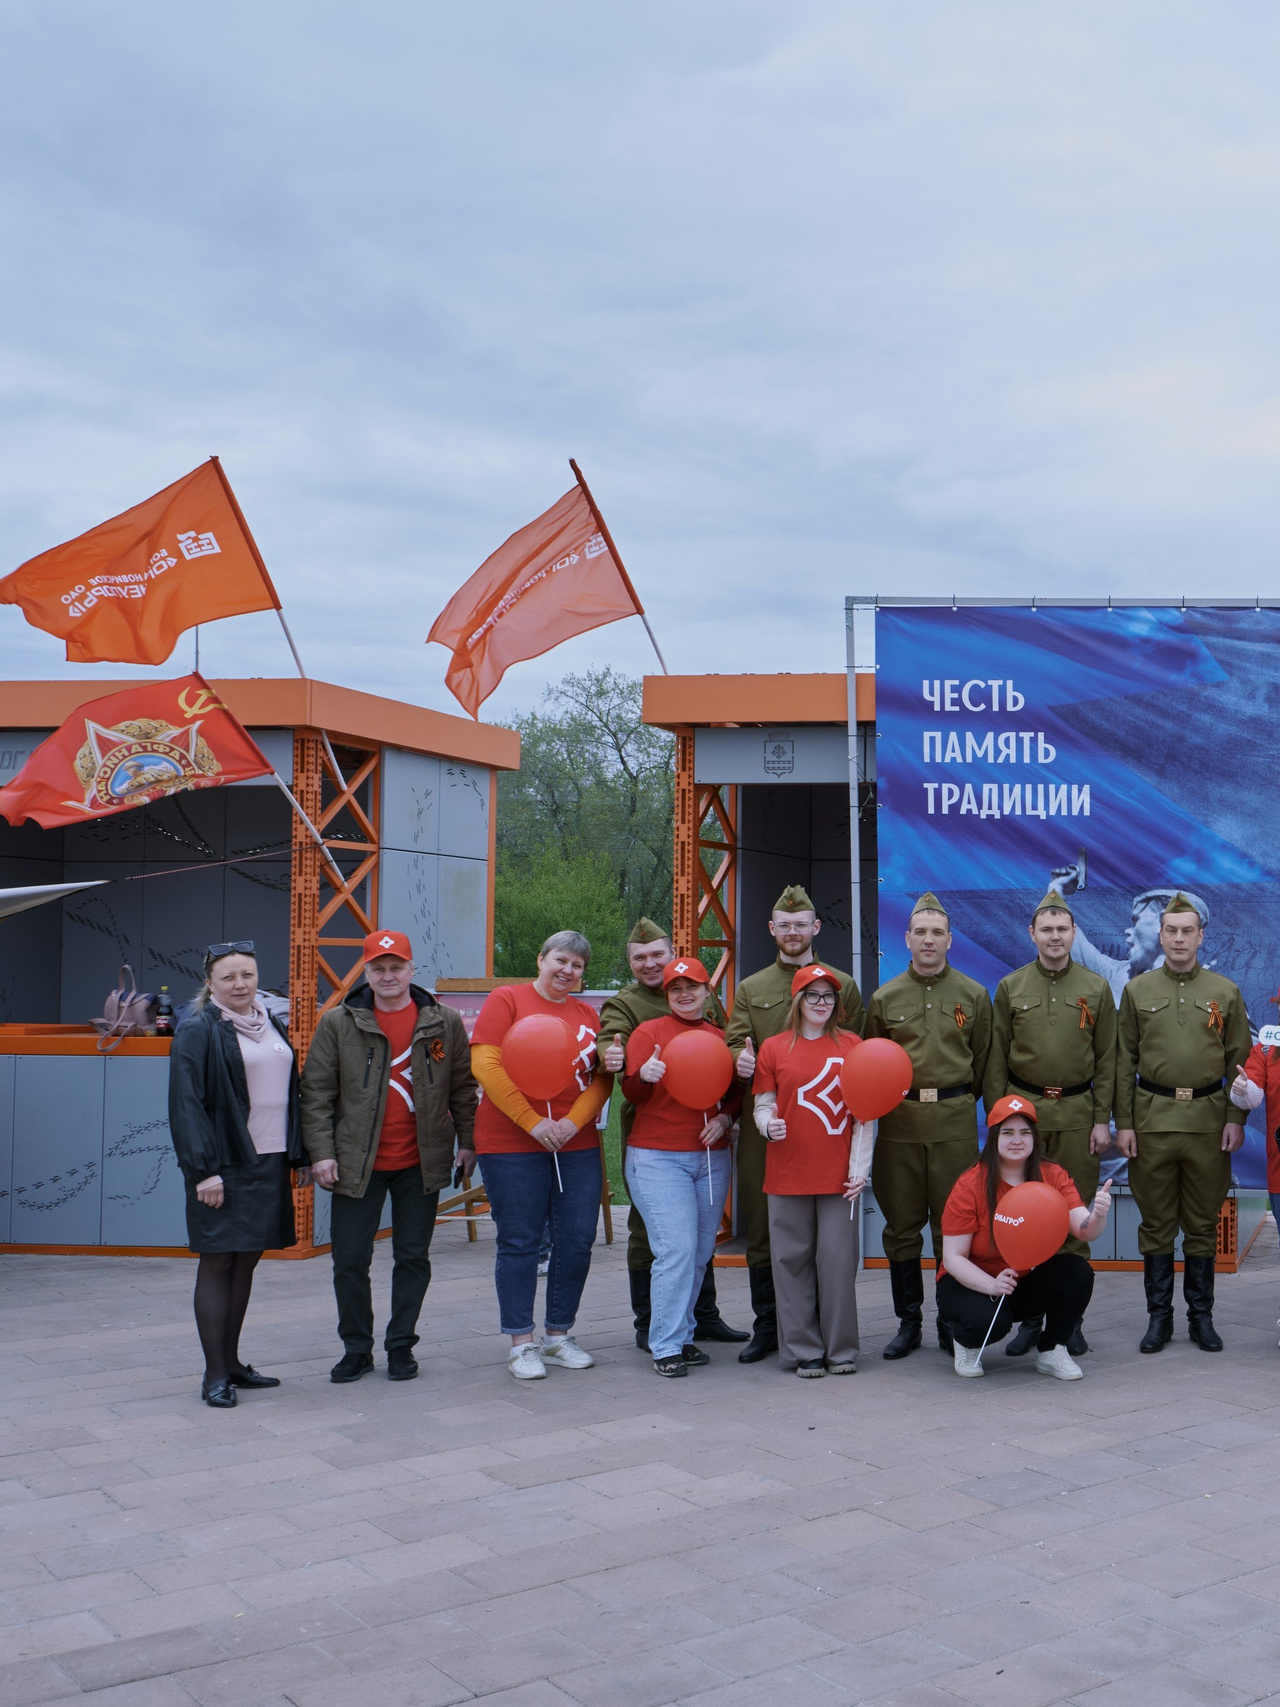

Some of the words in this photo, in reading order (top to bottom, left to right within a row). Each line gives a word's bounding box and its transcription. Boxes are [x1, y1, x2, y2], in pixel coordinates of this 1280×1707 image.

[922, 679, 1025, 713] ЧЕСТЬ
[923, 731, 1056, 764] ПАМЯТЬ
[923, 783, 1091, 820] ТРАДИЦИИ
